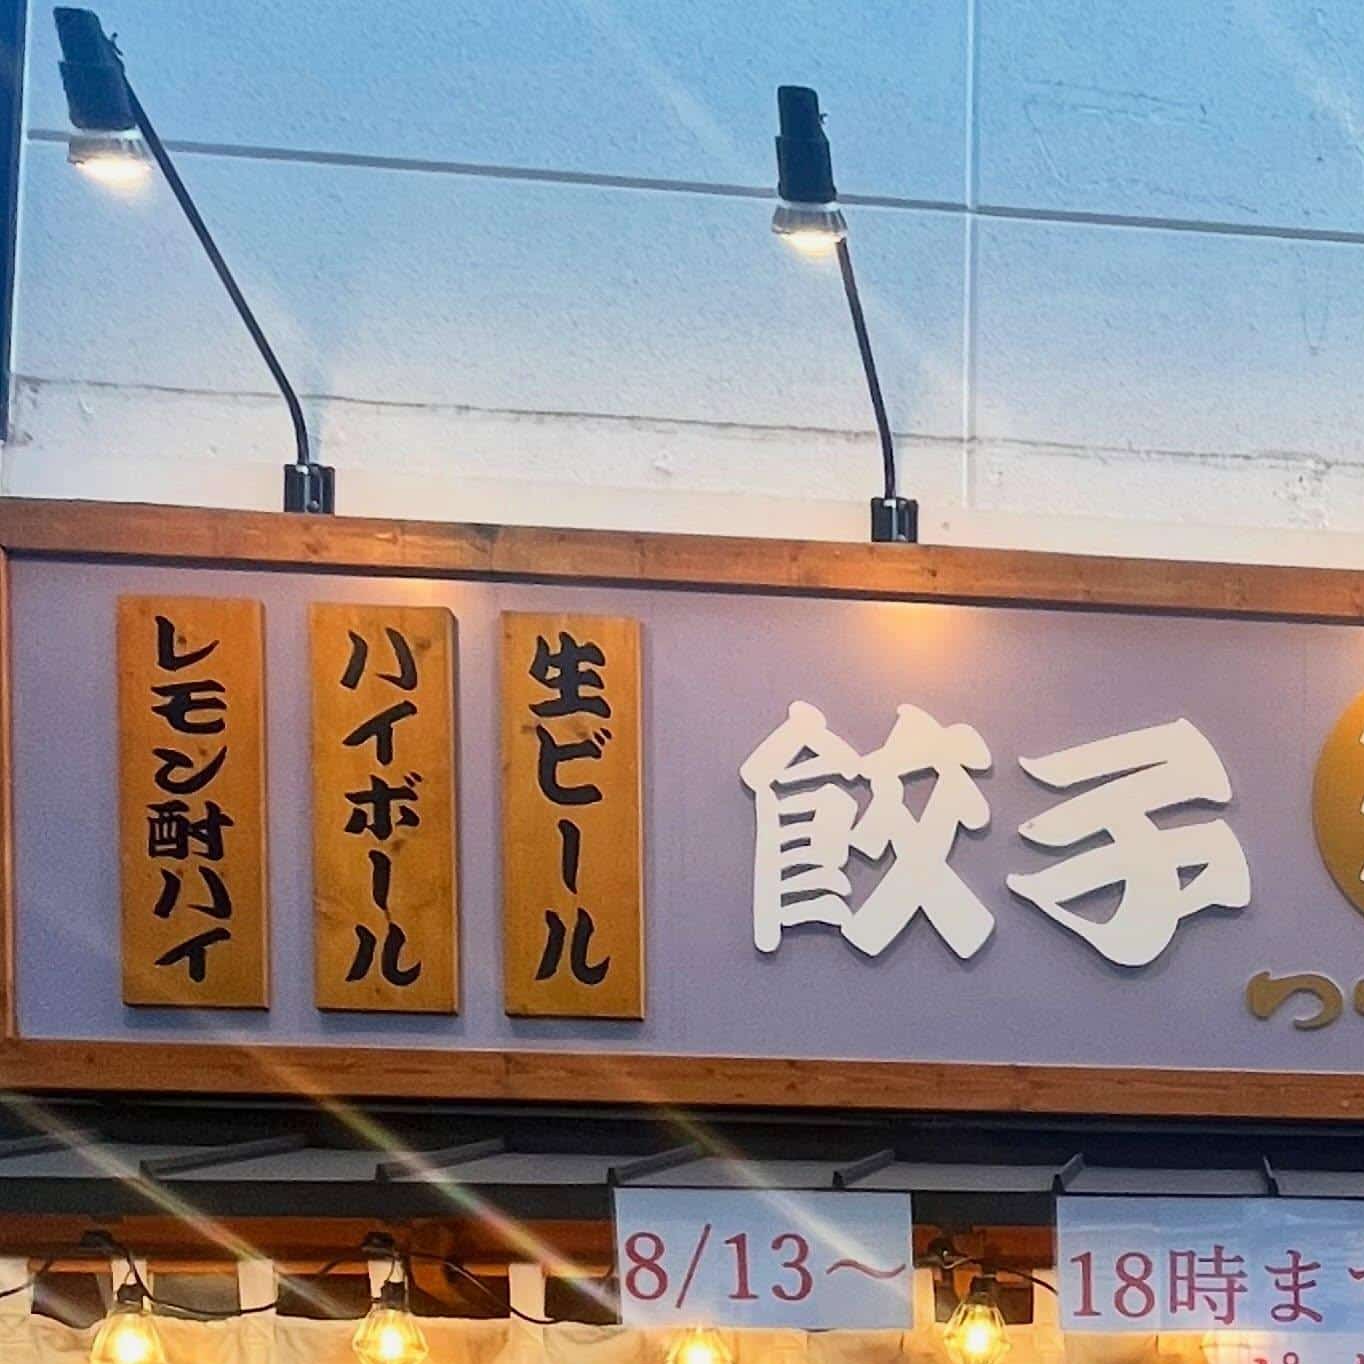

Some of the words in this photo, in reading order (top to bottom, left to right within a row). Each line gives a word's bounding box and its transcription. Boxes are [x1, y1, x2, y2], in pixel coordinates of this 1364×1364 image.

[147, 615, 234, 983] レモン酎ハイ
[340, 628, 423, 987] ハイボール
[528, 632, 611, 986] 生ビール
[740, 701, 1251, 967] 餃子
